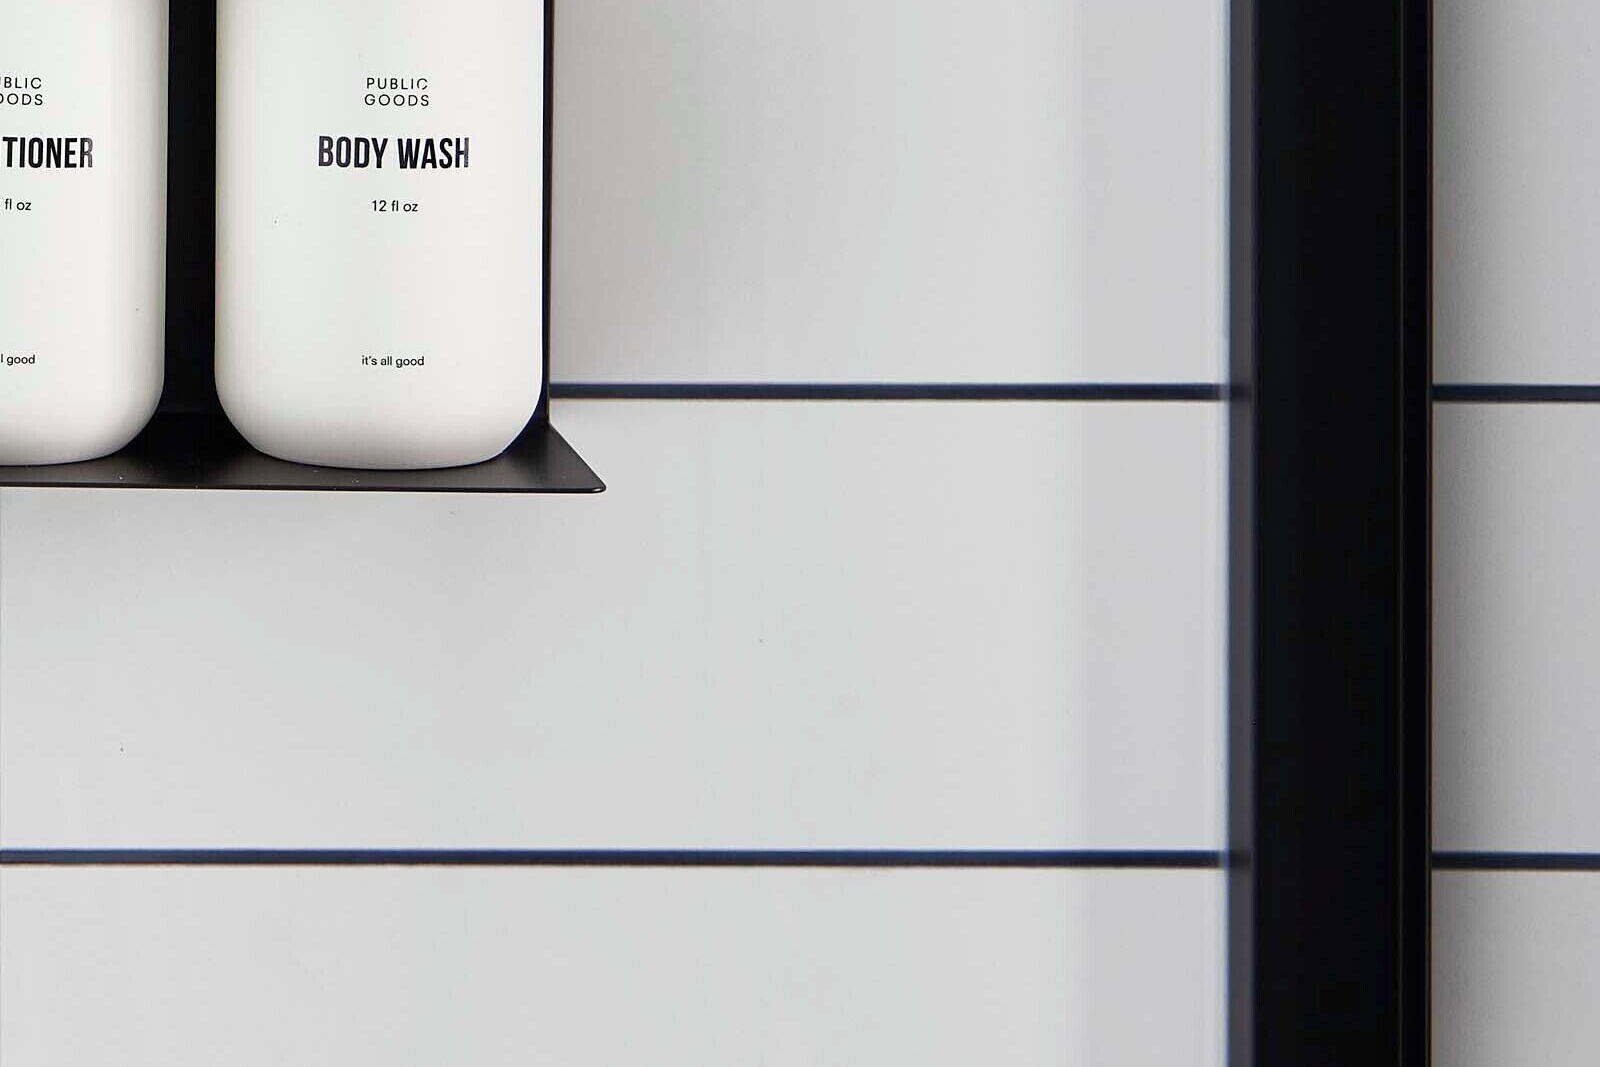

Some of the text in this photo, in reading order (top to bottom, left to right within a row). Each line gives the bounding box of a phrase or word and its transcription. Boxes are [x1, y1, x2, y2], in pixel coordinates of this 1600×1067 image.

[366, 77, 428, 91] PUBLIC
[364, 93, 430, 107] GOODS
[318, 135, 470, 170] BODY WASH
[4, 197, 13, 211] fl
[16, 201, 32, 212] oz
[371, 199, 419, 213] 12 fl oz
[6, 353, 36, 367] good
[361, 354, 425, 369] it's all good
